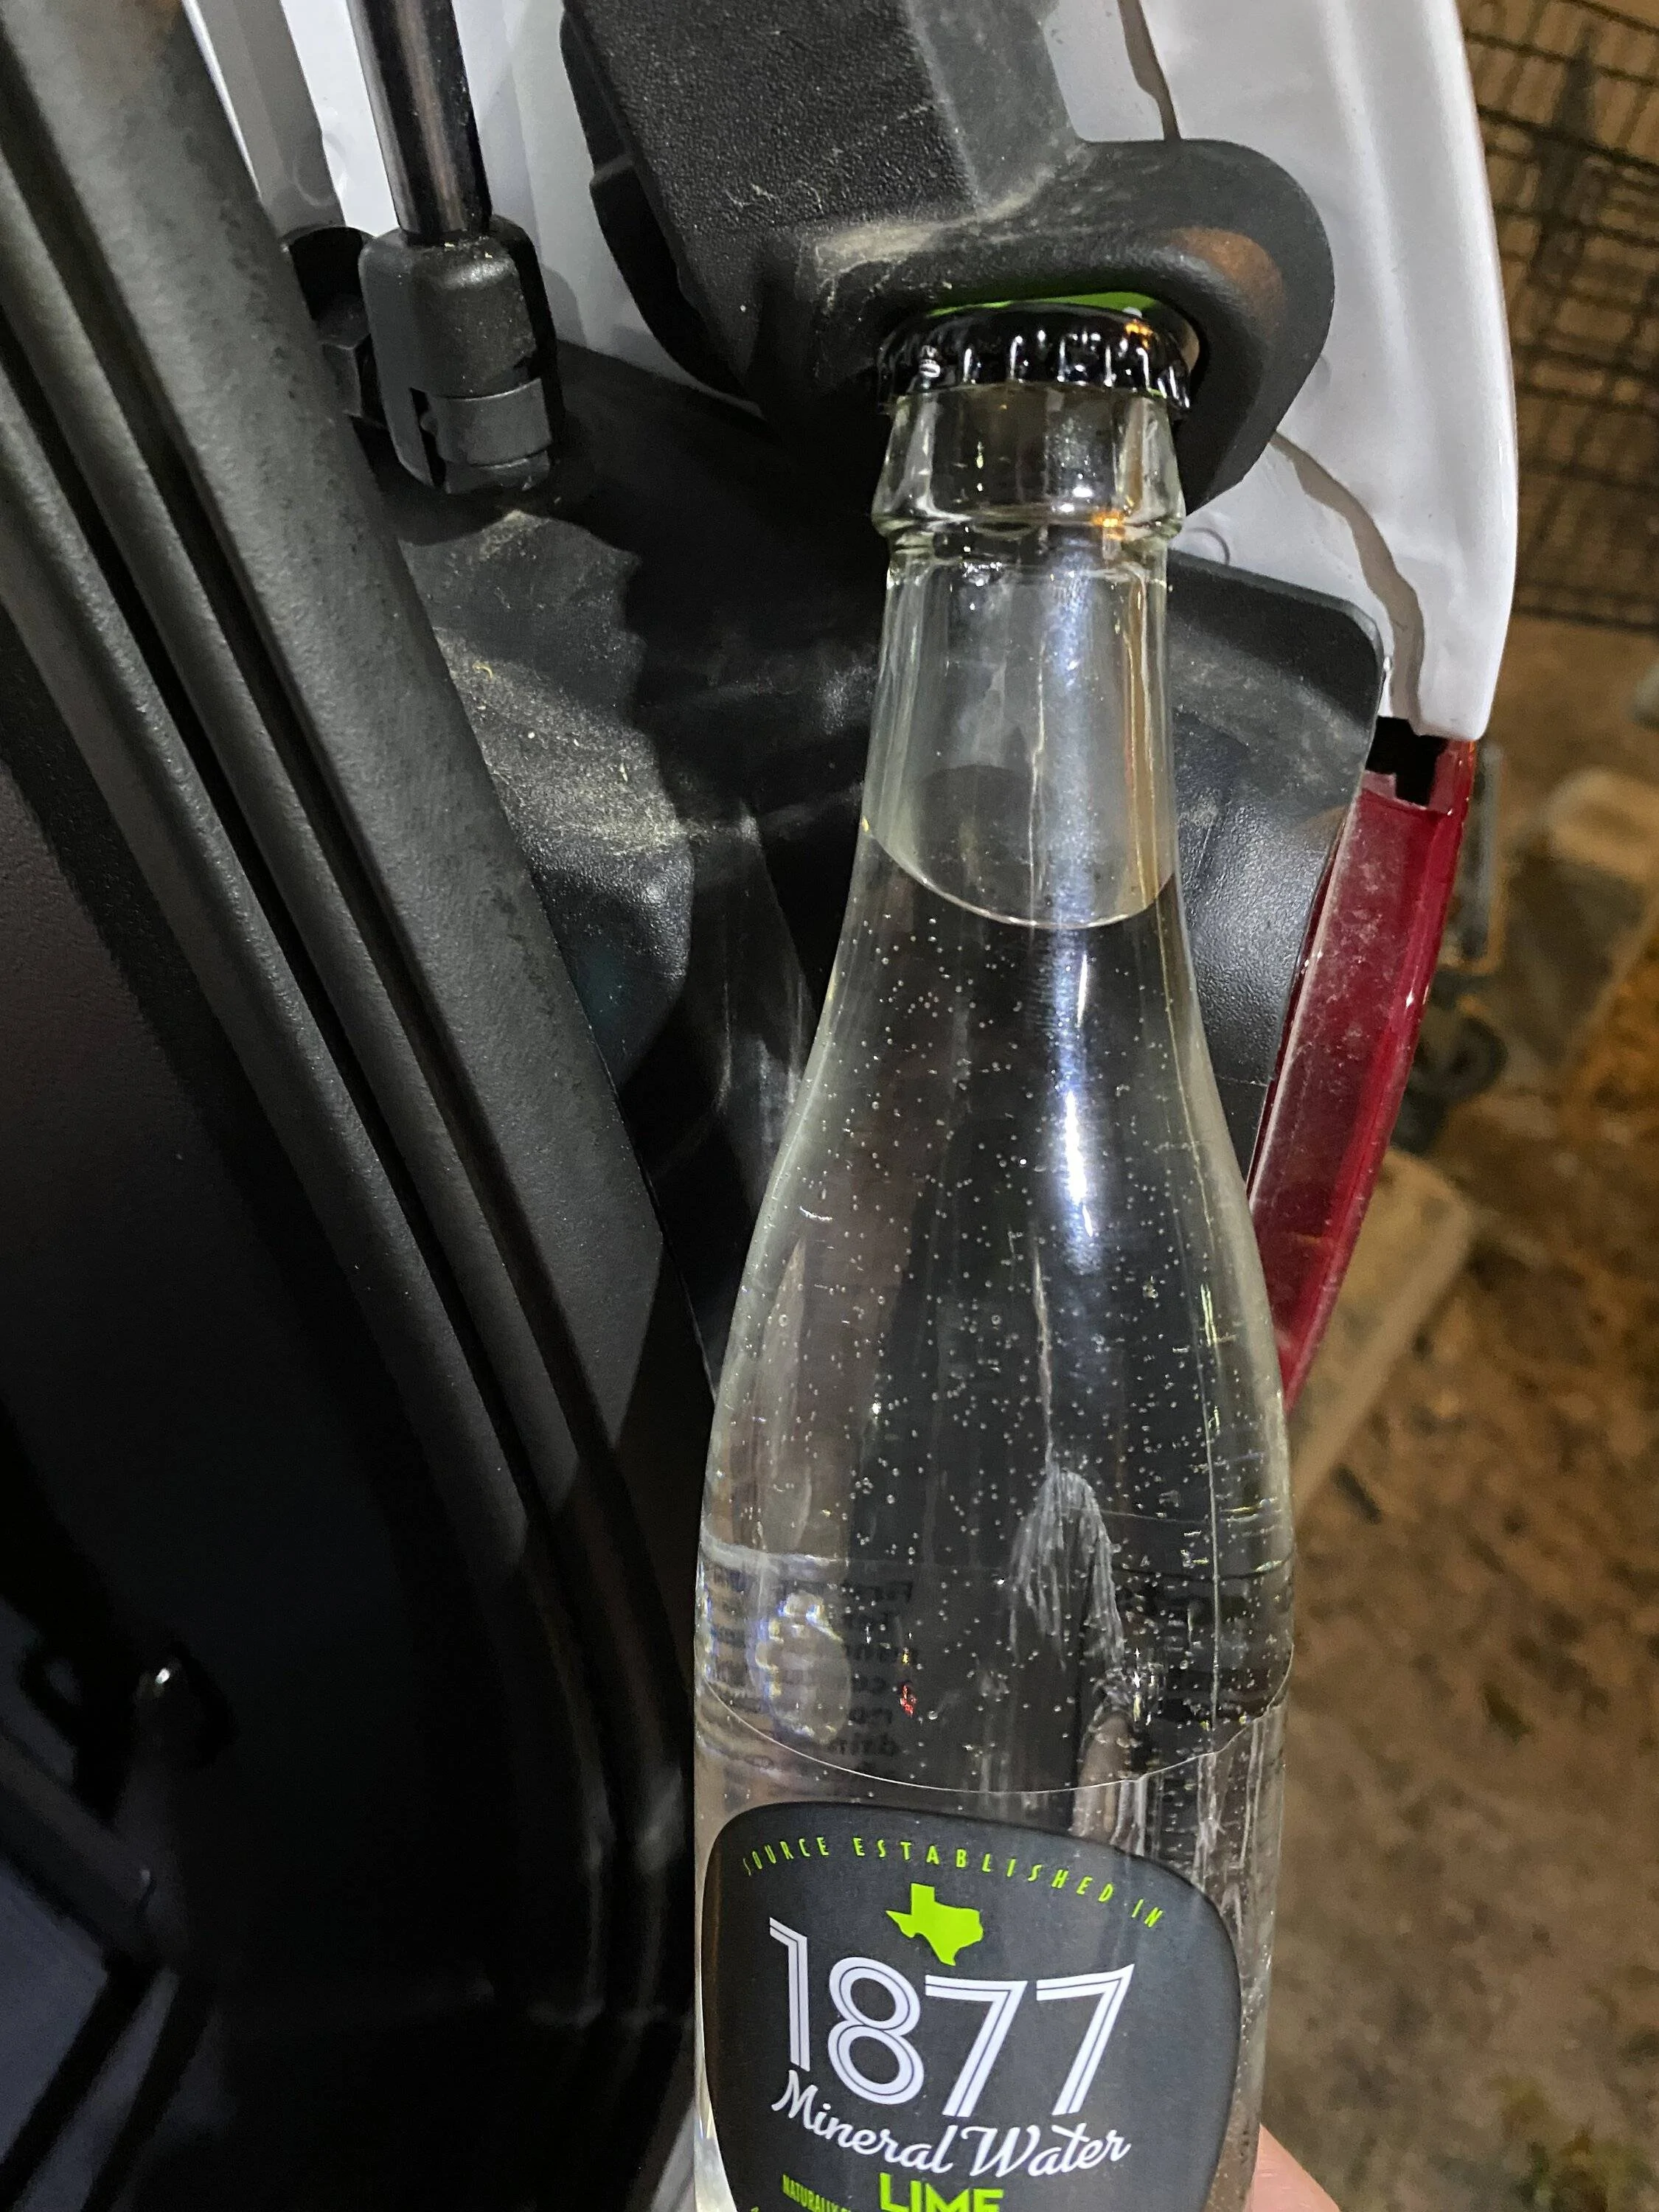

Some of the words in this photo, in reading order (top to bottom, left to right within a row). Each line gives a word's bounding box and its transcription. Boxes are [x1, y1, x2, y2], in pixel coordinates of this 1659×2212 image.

[743, 1837, 830, 1877] SOURCE
[852, 1837, 1115, 1903] ESTABLISHED
[1131, 1898, 1163, 1927] IN
[769, 1917, 1135, 2118] 1877
[771, 2068, 959, 2175] Mineral
[960, 2123, 1133, 2178] Water
[879, 2172, 1004, 2212] LIME
